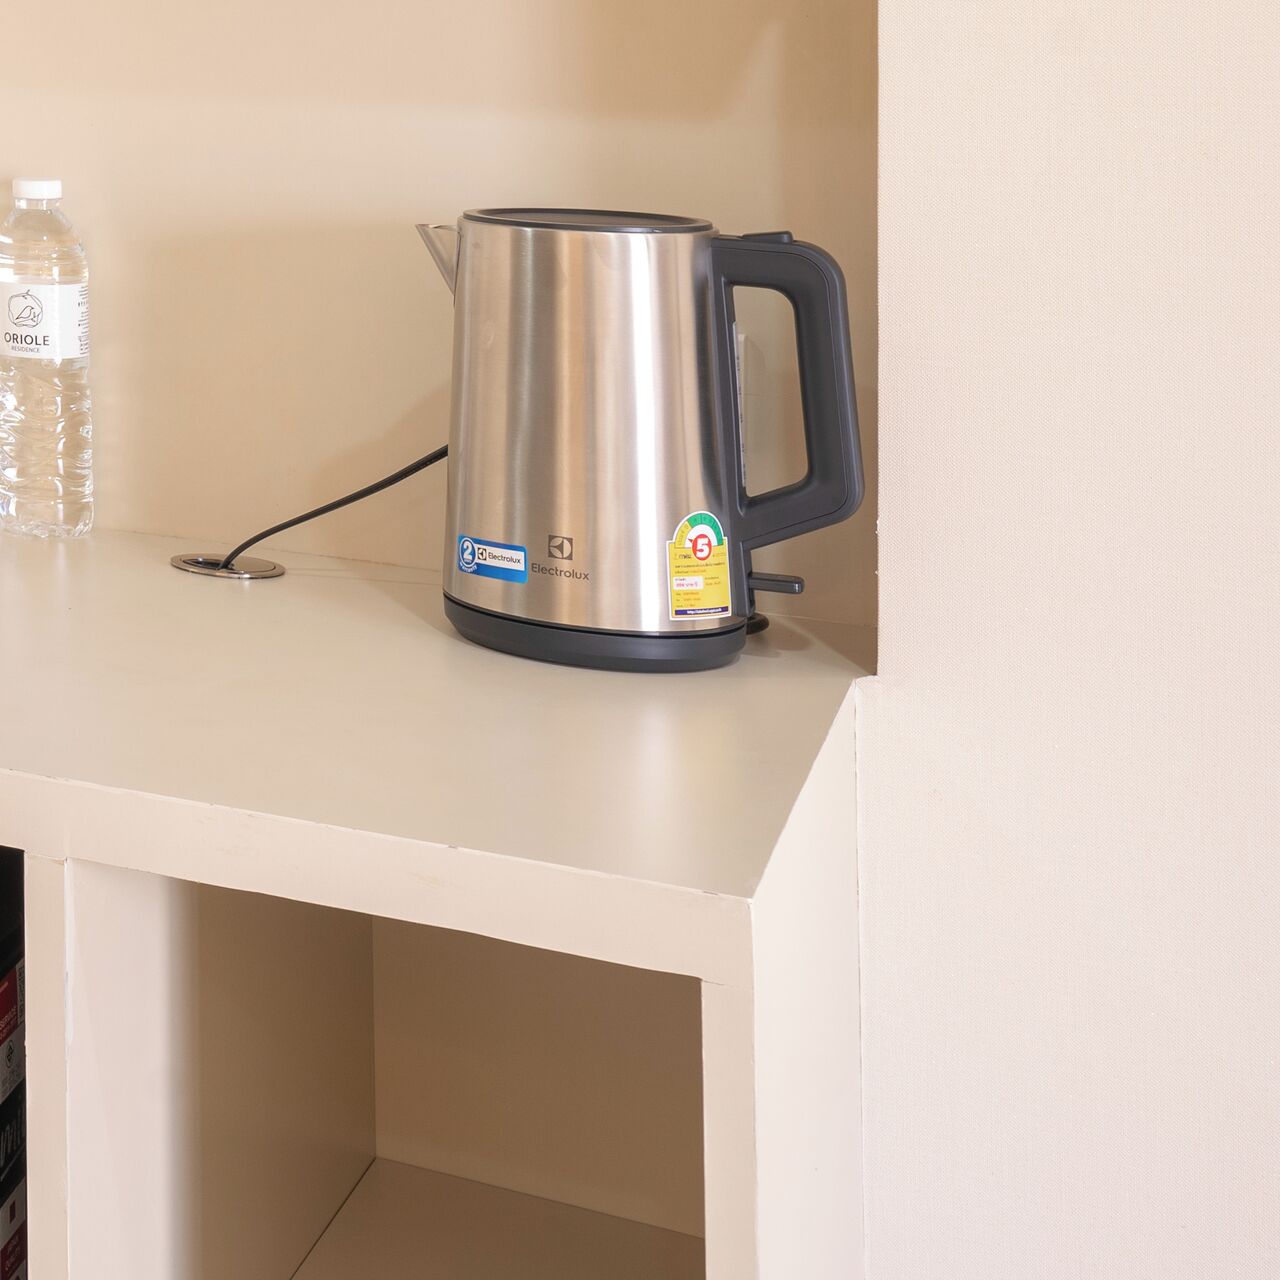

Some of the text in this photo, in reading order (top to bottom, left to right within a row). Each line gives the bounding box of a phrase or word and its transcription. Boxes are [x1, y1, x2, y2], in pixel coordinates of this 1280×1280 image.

[4, 332, 50, 346] ORIOLE
[11, 345, 40, 353] RESIDENCE
[463, 541, 473, 561] 2
[695, 537, 710, 558] 5
[488, 552, 522, 564] Electrolux
[531, 562, 590, 580] Electrolux
